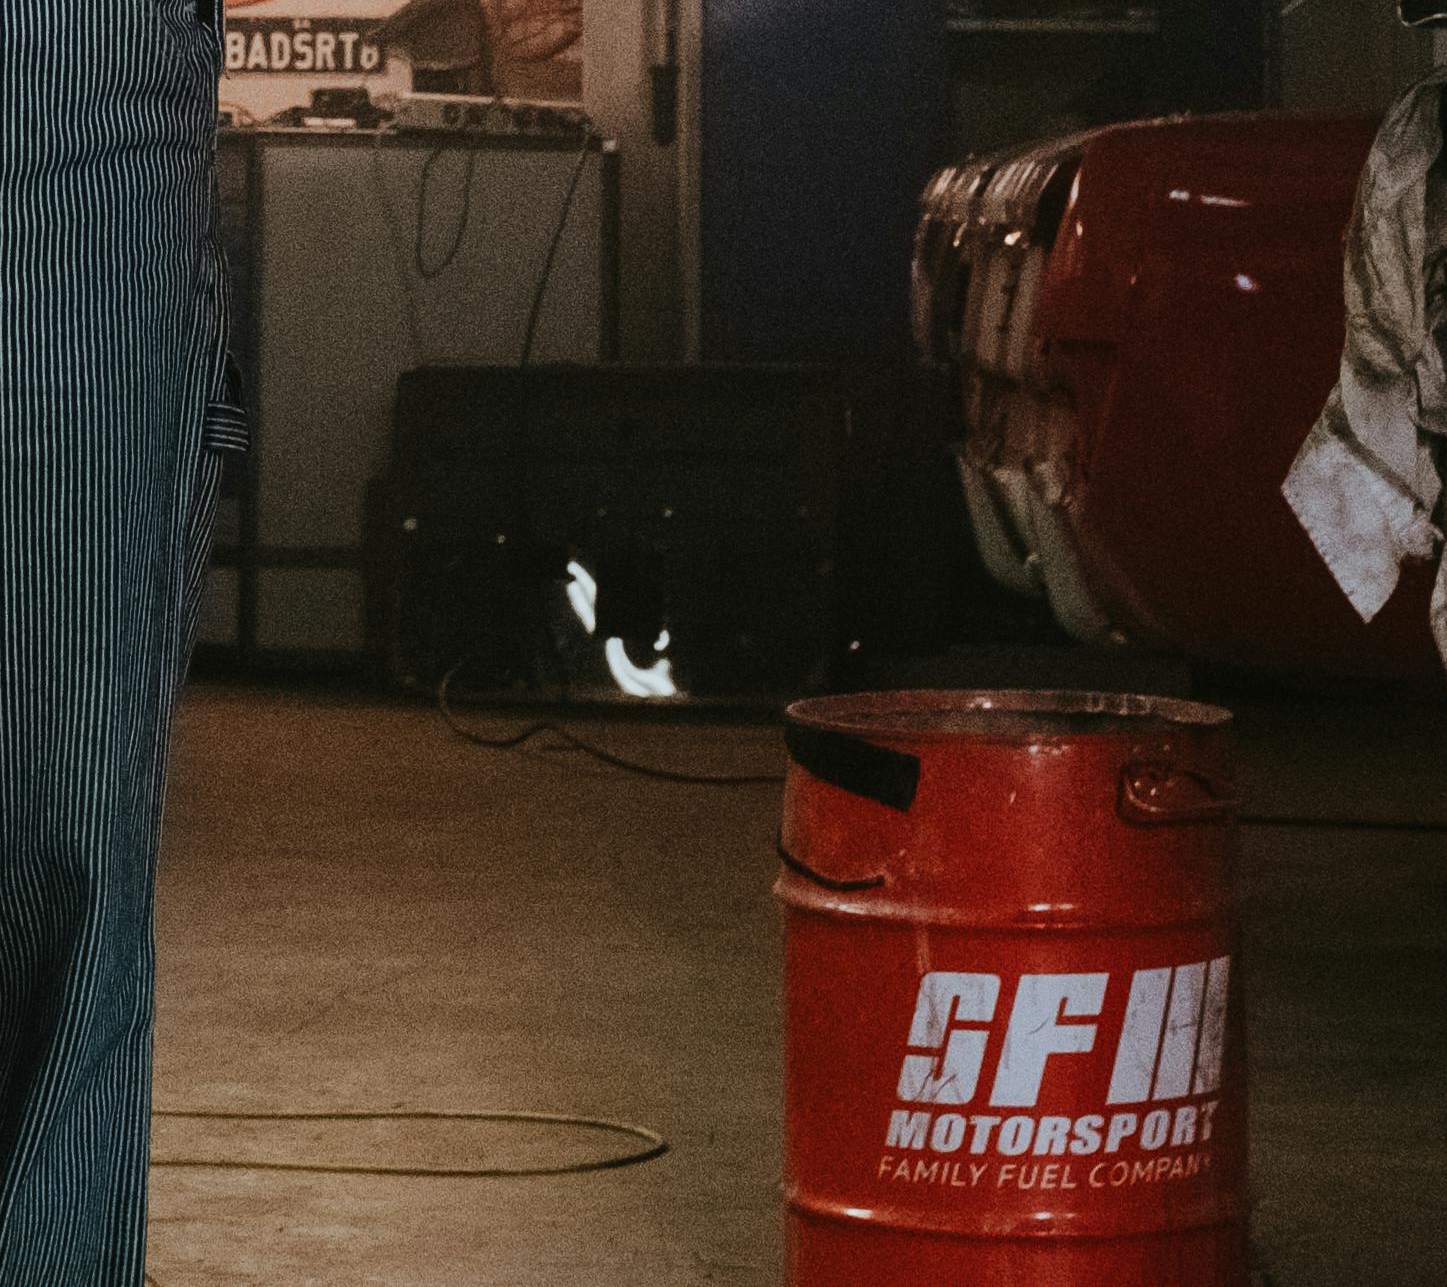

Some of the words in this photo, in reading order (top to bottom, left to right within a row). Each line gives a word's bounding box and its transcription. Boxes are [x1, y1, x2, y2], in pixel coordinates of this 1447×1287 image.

[884, 1100, 1219, 1158] MOTORSPORT
[878, 1155, 988, 1189] FAMILY
[997, 1162, 1077, 1190] FUEL
